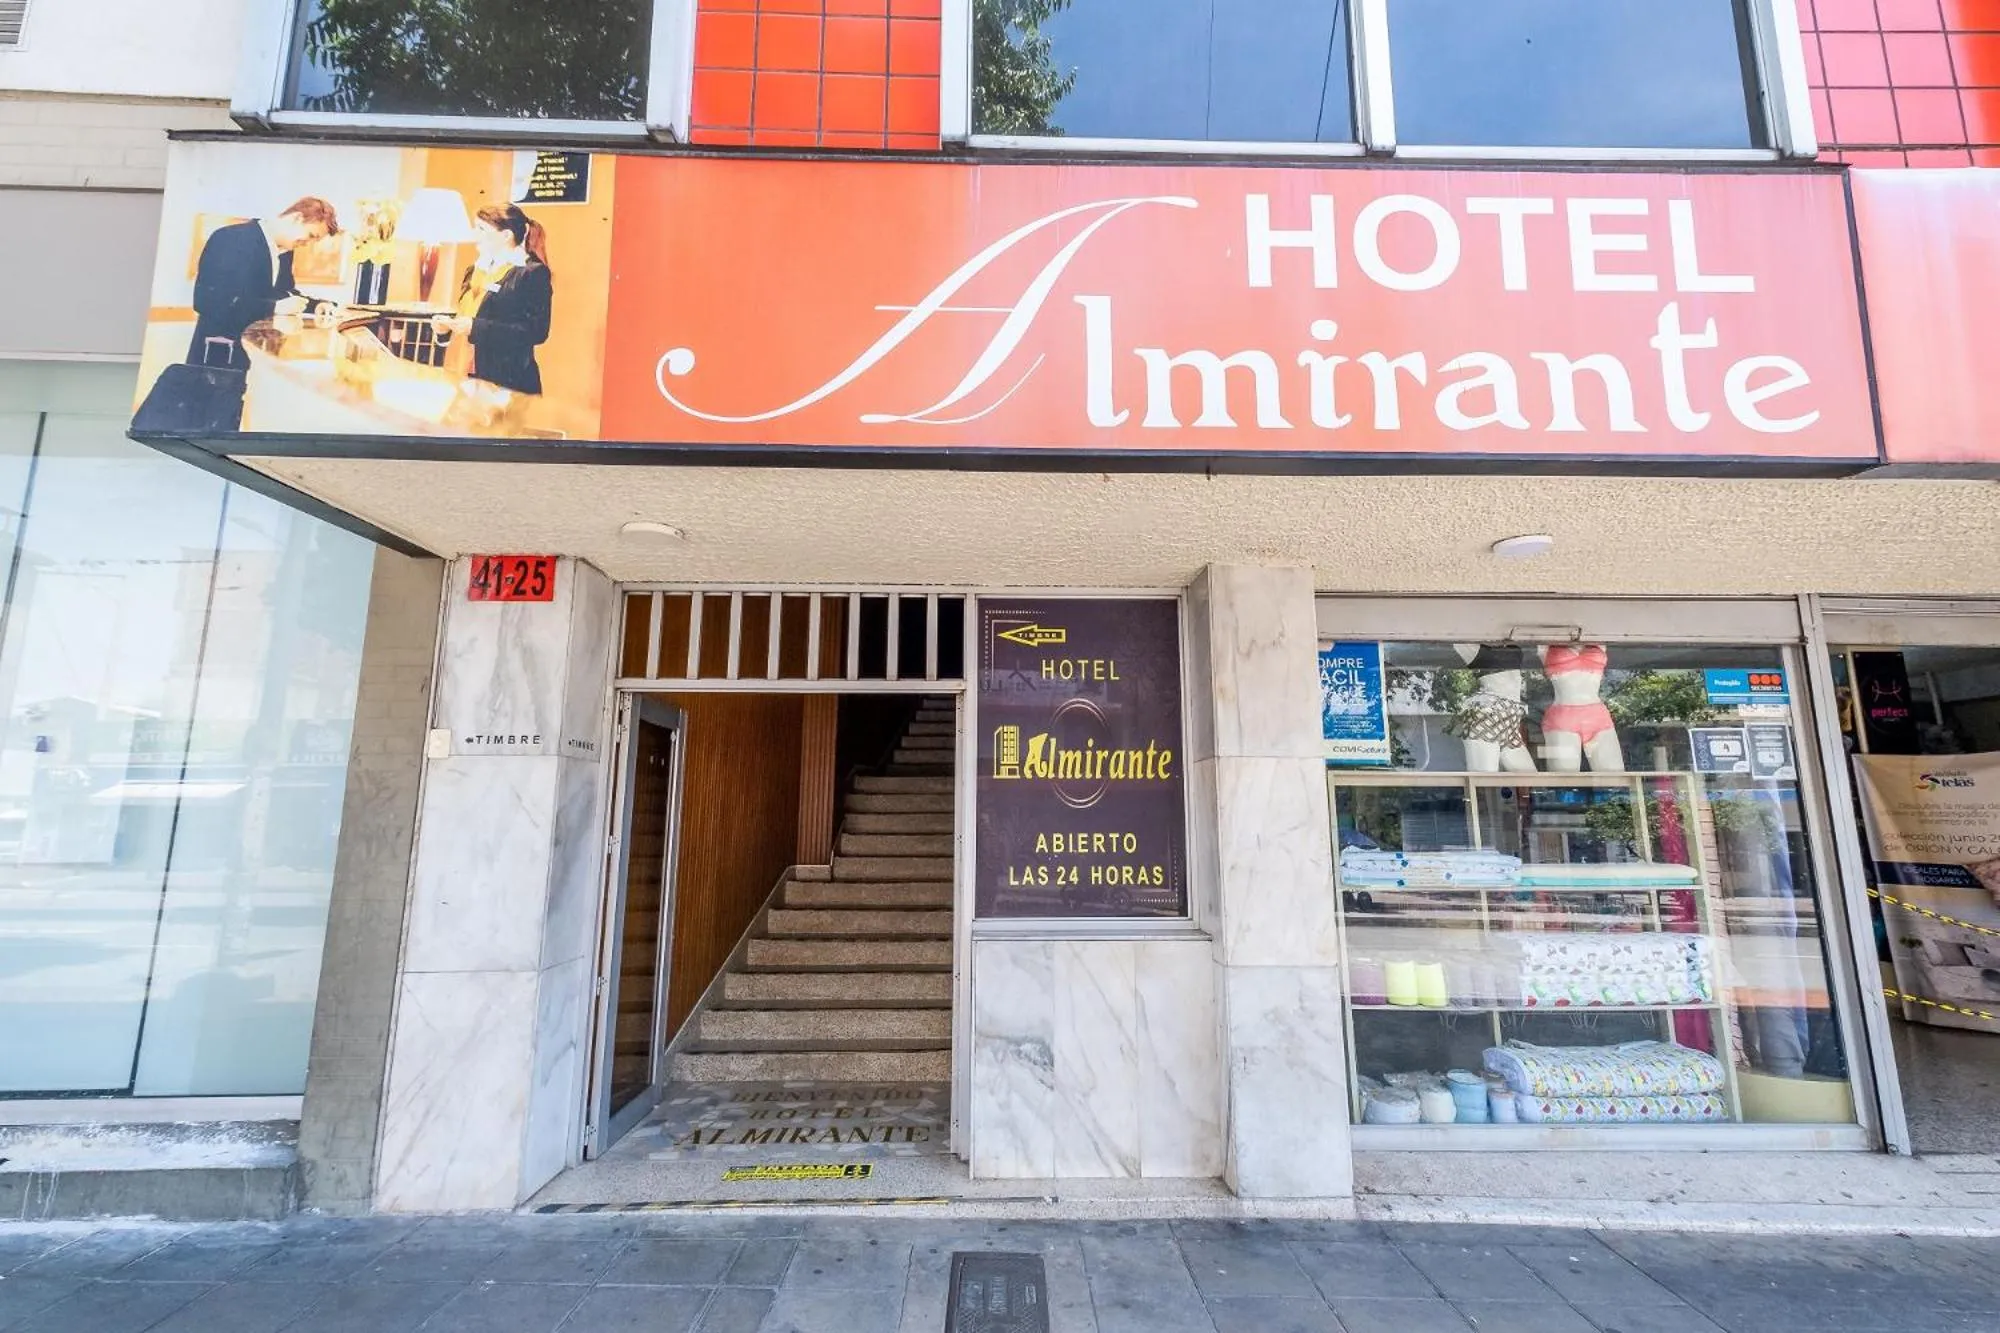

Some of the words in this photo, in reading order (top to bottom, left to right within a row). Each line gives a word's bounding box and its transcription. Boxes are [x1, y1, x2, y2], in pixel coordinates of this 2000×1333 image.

[1245, 193, 1756, 293] HOTEL
[655, 196, 1820, 434] Almirante
[1041, 659, 1120, 681] HOTEL
[1317, 657, 1365, 669] OMPRE
[475, 735, 541, 745] TIMBRE
[1023, 732, 1172, 780] Almirante
[1035, 832, 1138, 854] ABIERTO
[1009, 866, 1049, 886] LAS
[1056, 866, 1078, 885] 24
[1090, 866, 1165, 886] HORAS
[728, 1087, 926, 1103] BIENVENIDO
[749, 1106, 884, 1120] HOTEL
[673, 1125, 931, 1146] ALMIRANTE
